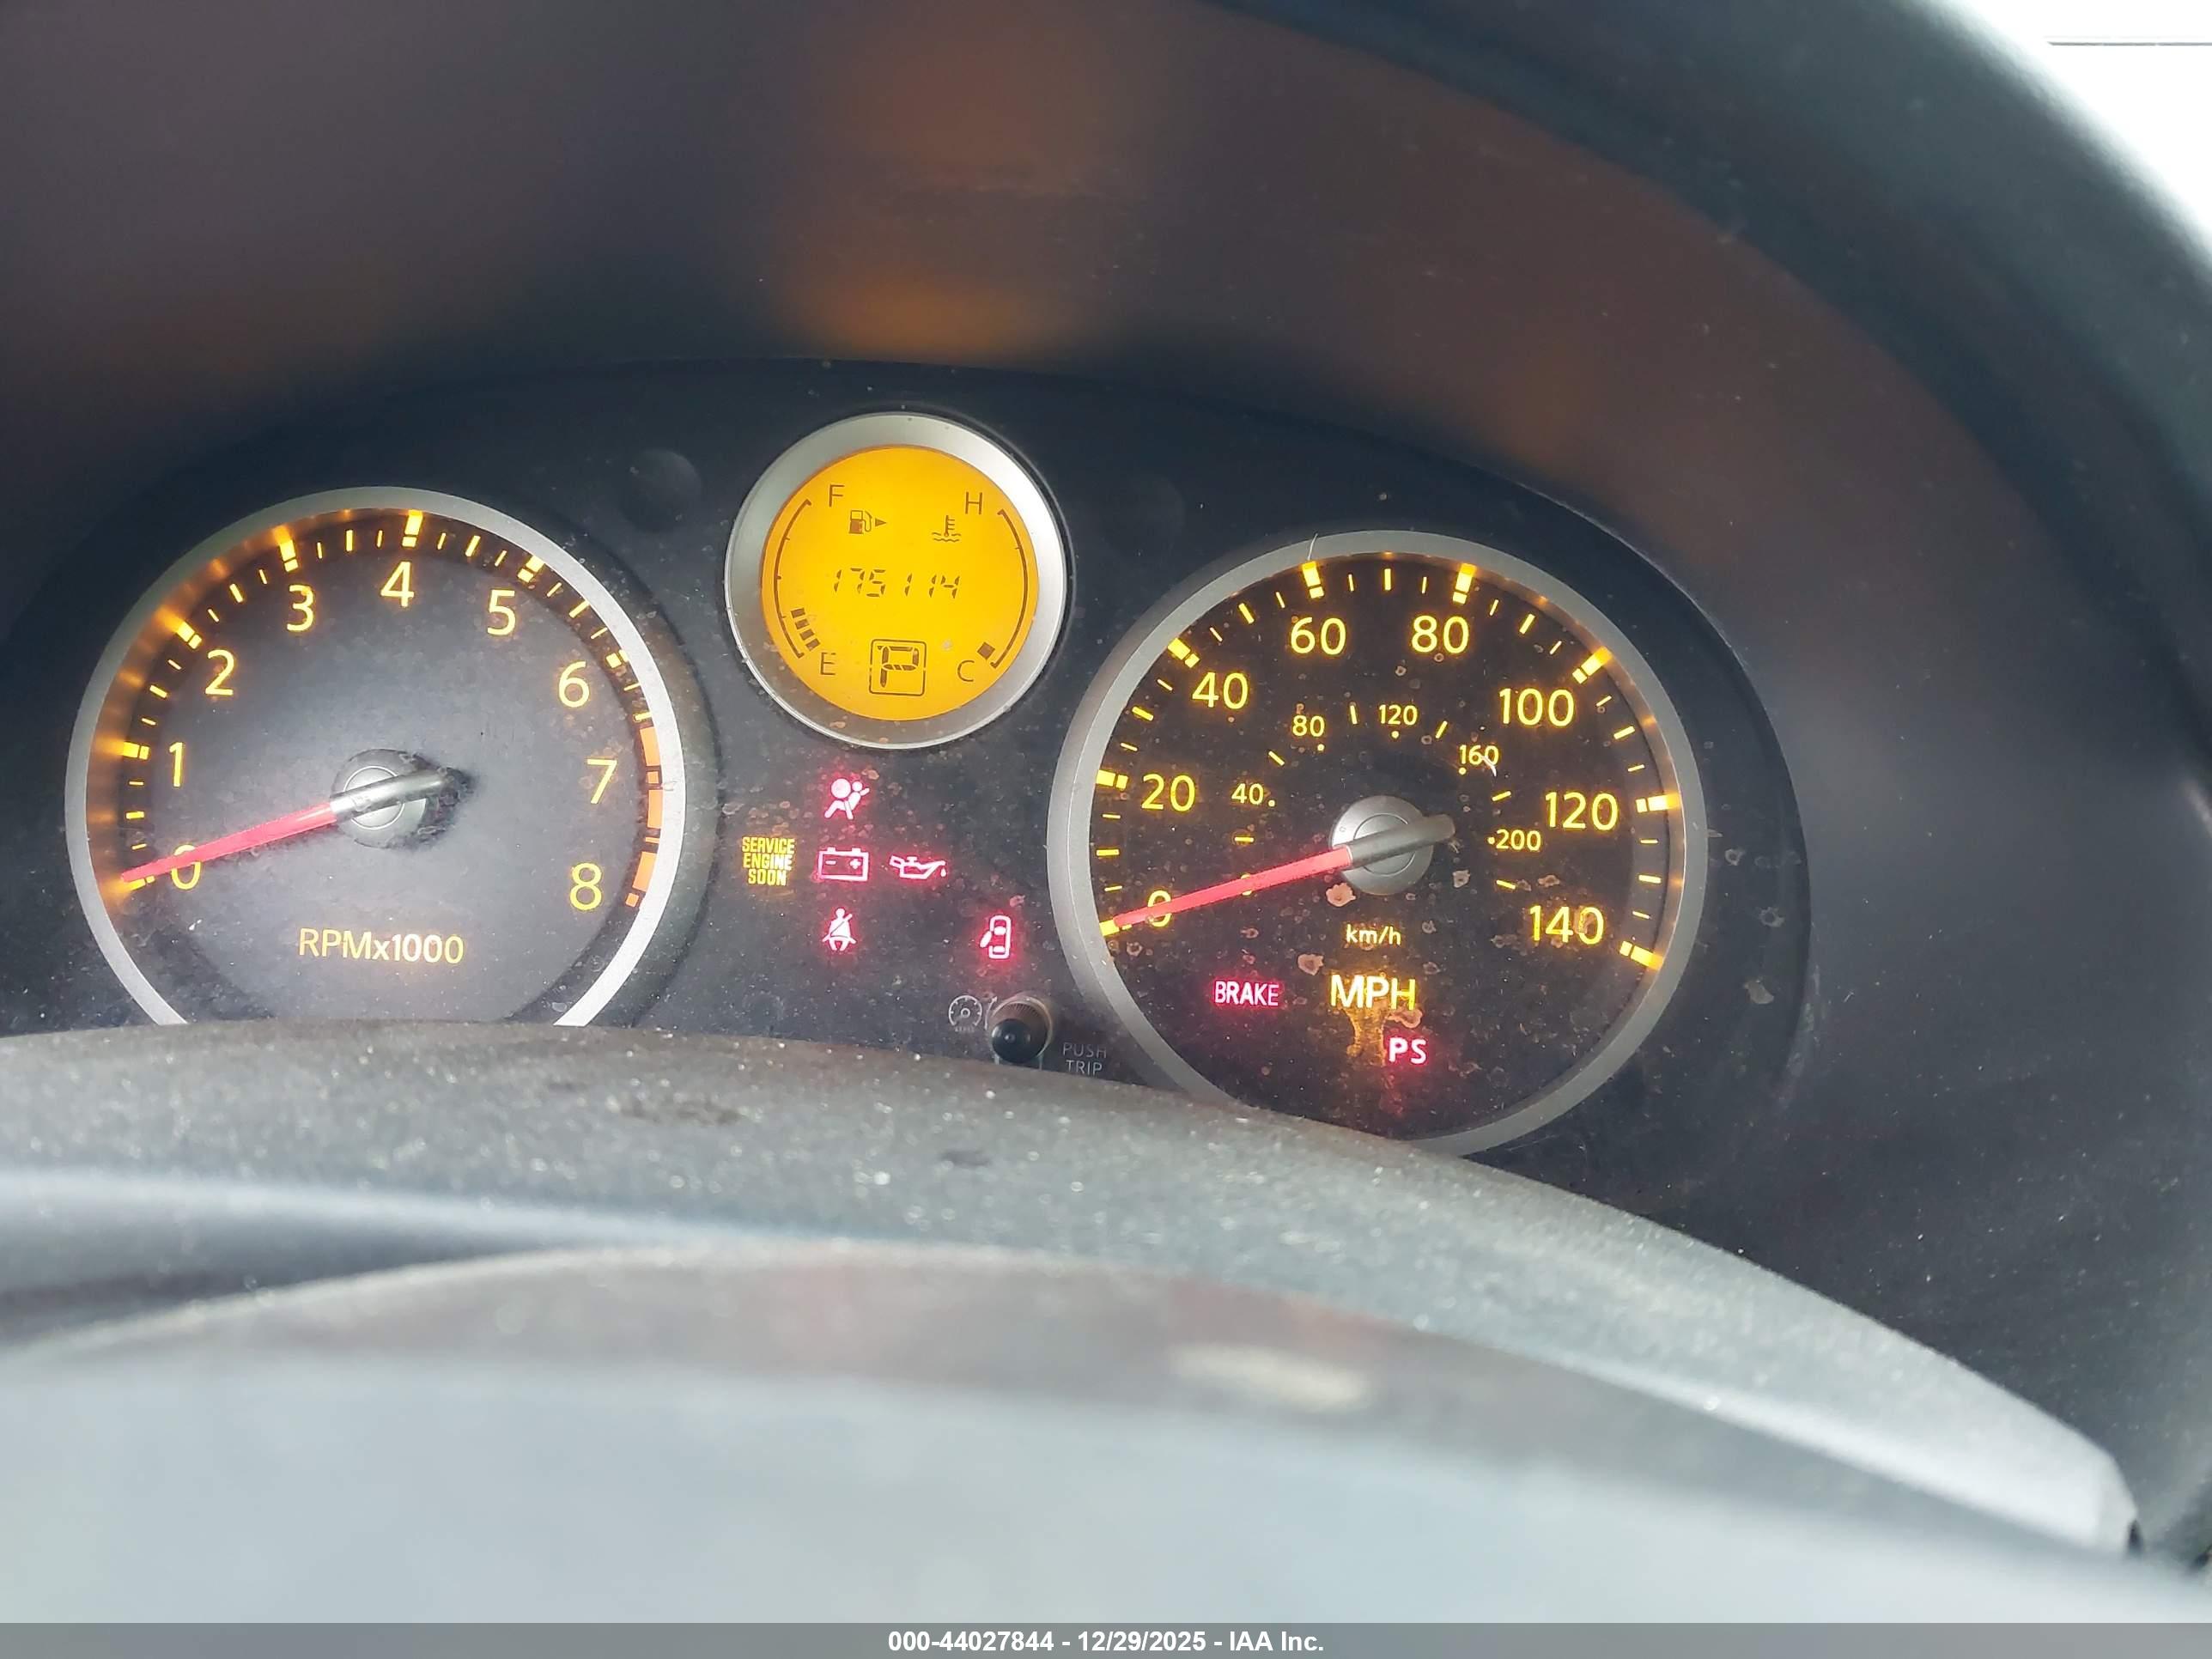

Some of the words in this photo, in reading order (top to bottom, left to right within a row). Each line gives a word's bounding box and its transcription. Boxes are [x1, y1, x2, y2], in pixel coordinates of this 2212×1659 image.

[829, 483, 845, 507] F
[964, 491, 983, 515] H
[380, 561, 415, 607] 4
[833, 567, 961, 599] 175114
[286, 584, 315, 632] 3
[487, 589, 516, 636] 5
[1290, 617, 1347, 655] 60
[1411, 615, 1470, 655] 80
[205, 649, 236, 696] 2
[820, 652, 837, 676] E
[878, 645, 920, 688] P
[957, 659, 975, 683] C
[557, 659, 591, 708] 6
[1192, 672, 1249, 710] 40
[1378, 703, 1419, 726] 120
[1498, 688, 1575, 727] 100
[1291, 714, 1326, 738] 80
[168, 741, 184, 787] 1
[1459, 744, 1500, 766] 160
[586, 757, 617, 805] 7
[1140, 775, 1196, 812] 20
[1231, 783, 1265, 805] 40
[1545, 791, 1619, 831] 120
[742, 836, 795, 854] SERVICE
[1496, 829, 1542, 852] 200
[744, 852, 793, 871] ENGINE
[748, 868, 787, 886] SOON
[569, 862, 603, 911] 8
[1346, 924, 1402, 946] km/h
[1528, 904, 1604, 945] 140
[299, 927, 465, 964] RPMx1000
[1213, 981, 1279, 1006] BRAKE
[1329, 974, 1417, 1012] MPH
[1062, 1042, 1108, 1059] PUSH
[1066, 1059, 1103, 1076] TRIP
[1389, 1038, 1428, 1064] PS
